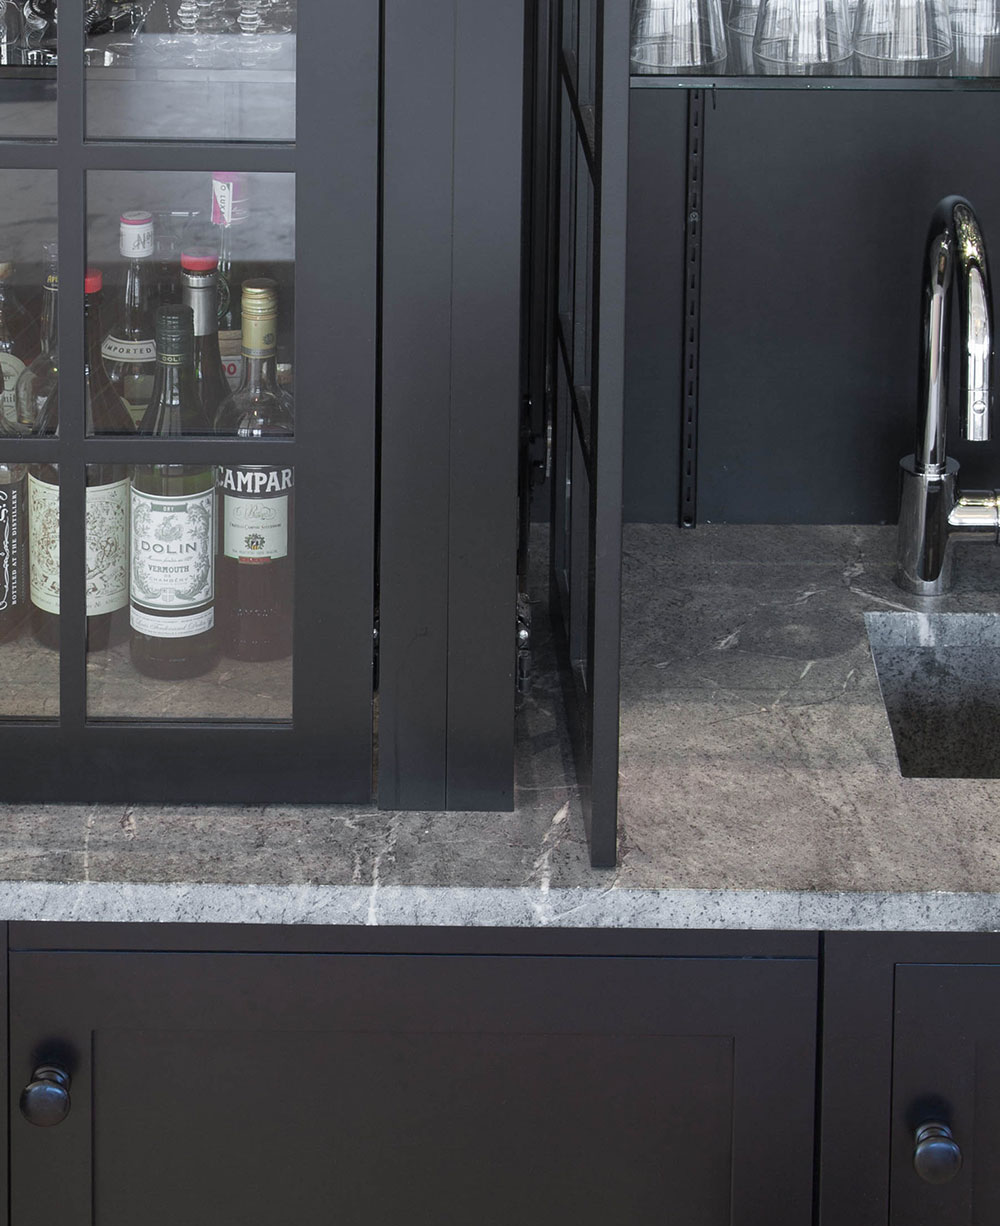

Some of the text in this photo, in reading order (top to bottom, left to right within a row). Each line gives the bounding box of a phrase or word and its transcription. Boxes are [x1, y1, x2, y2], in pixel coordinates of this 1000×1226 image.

[105, 344, 152, 354] IMPORTED
[141, 541, 197, 554] DOLIN
[148, 565, 189, 573] VERMOUTH
